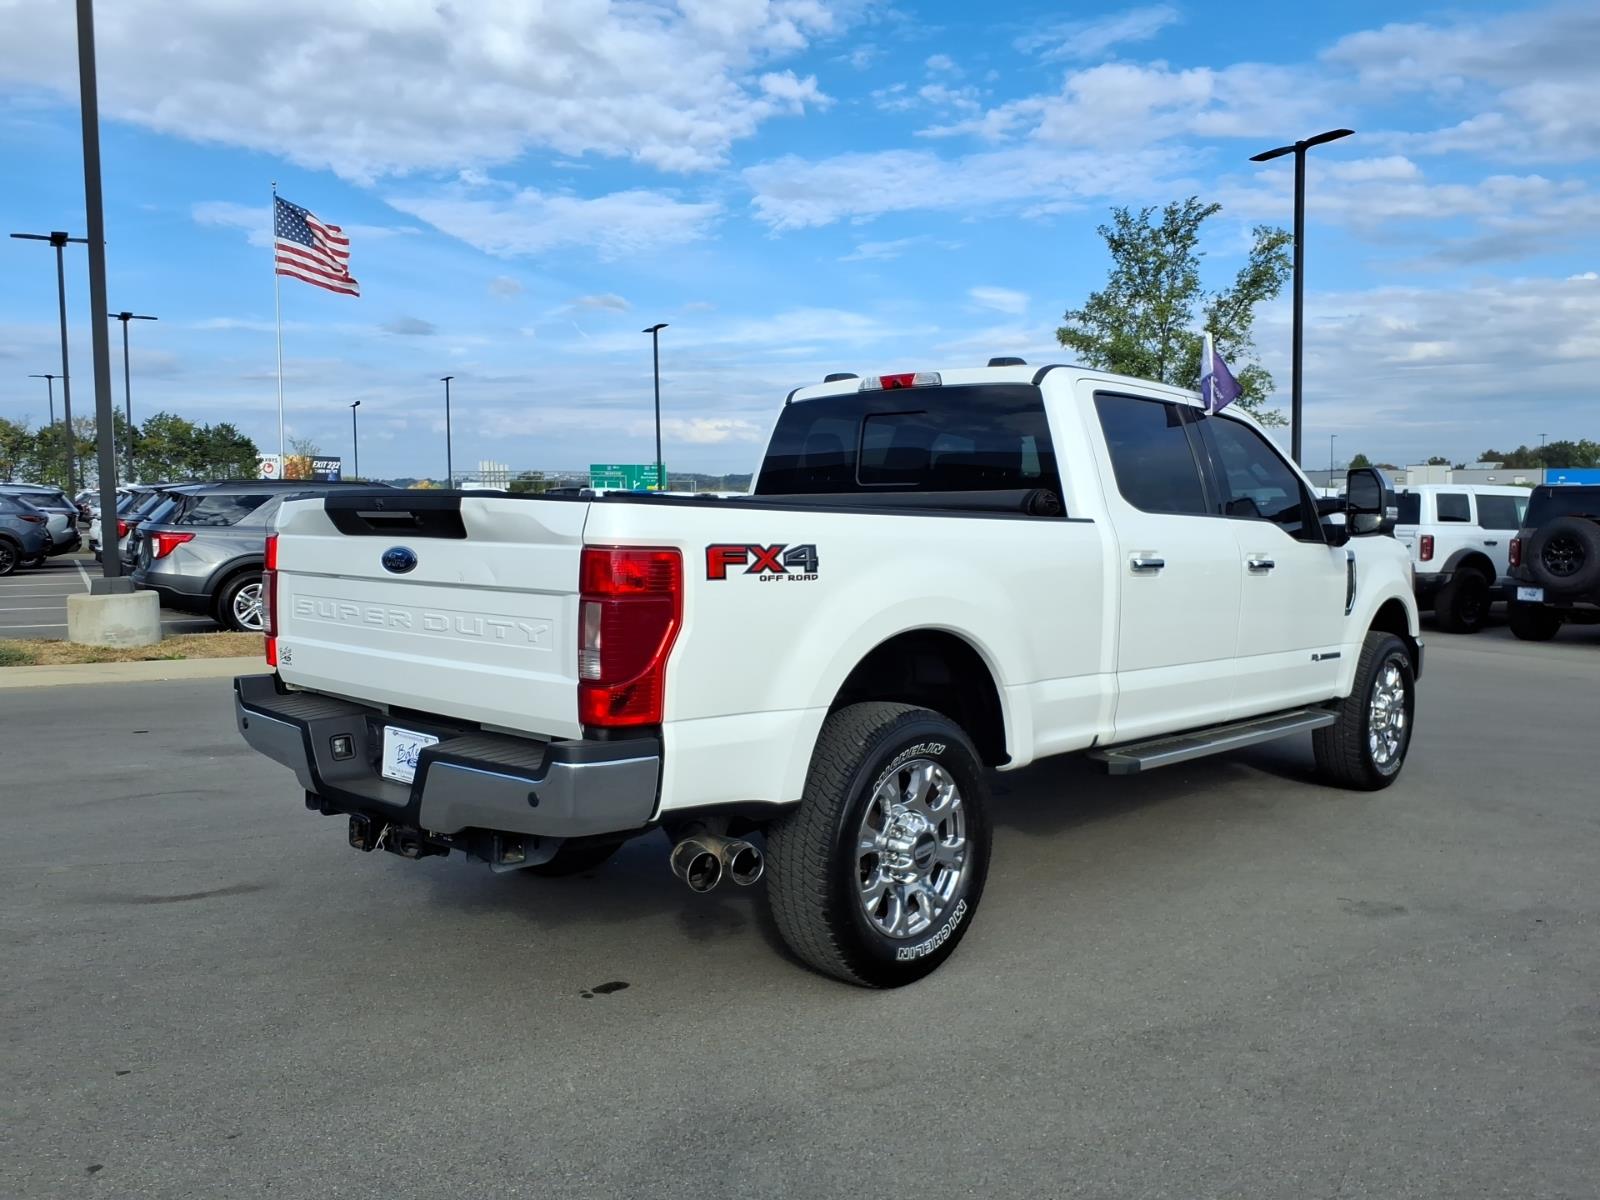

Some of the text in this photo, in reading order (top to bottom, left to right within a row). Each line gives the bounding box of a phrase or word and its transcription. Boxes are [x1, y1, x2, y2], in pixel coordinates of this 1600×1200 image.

[312, 460, 328, 468] EXIT
[705, 543, 819, 581] FX4
[759, 574, 819, 582] OFF ROAD
[295, 598, 549, 643] SUPER DUTY
[896, 899, 968, 960] MICHELIN
